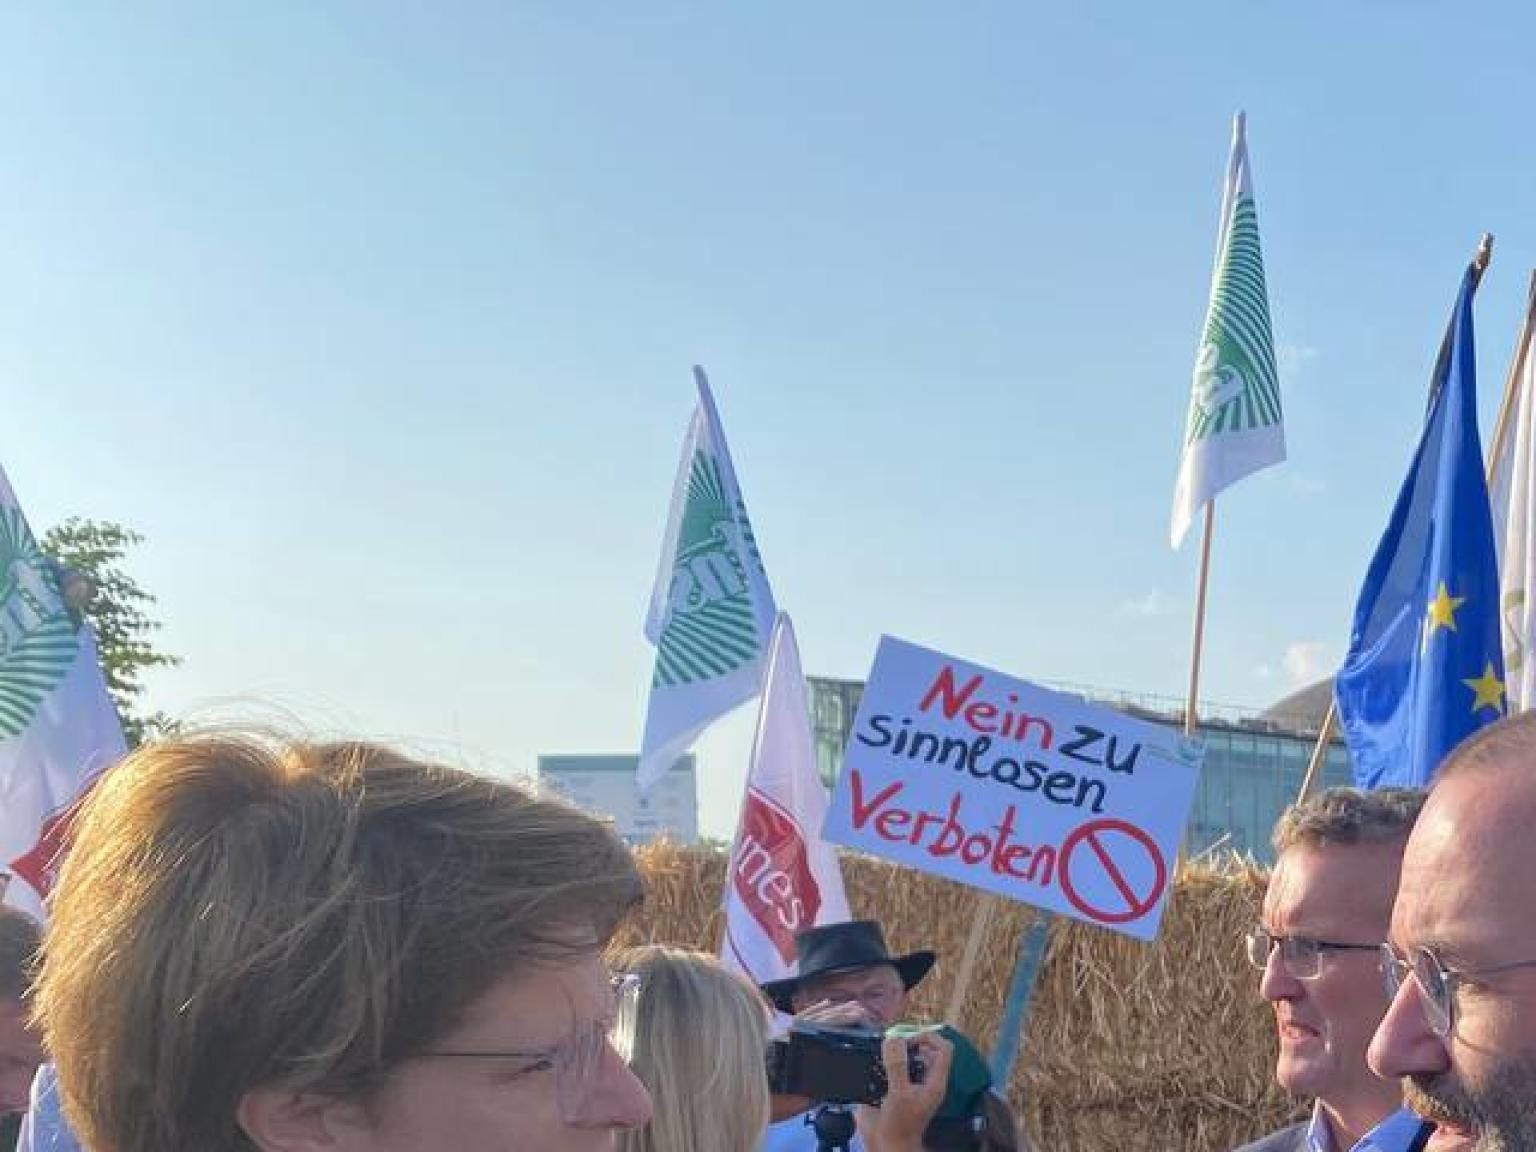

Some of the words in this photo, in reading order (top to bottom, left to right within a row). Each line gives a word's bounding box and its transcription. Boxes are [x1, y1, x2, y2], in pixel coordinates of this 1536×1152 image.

[856, 714, 1110, 813] sinnlosen
[919, 665, 1053, 750] Nein
[1059, 725, 1143, 775] zu
[849, 768, 1058, 888] Verboten
